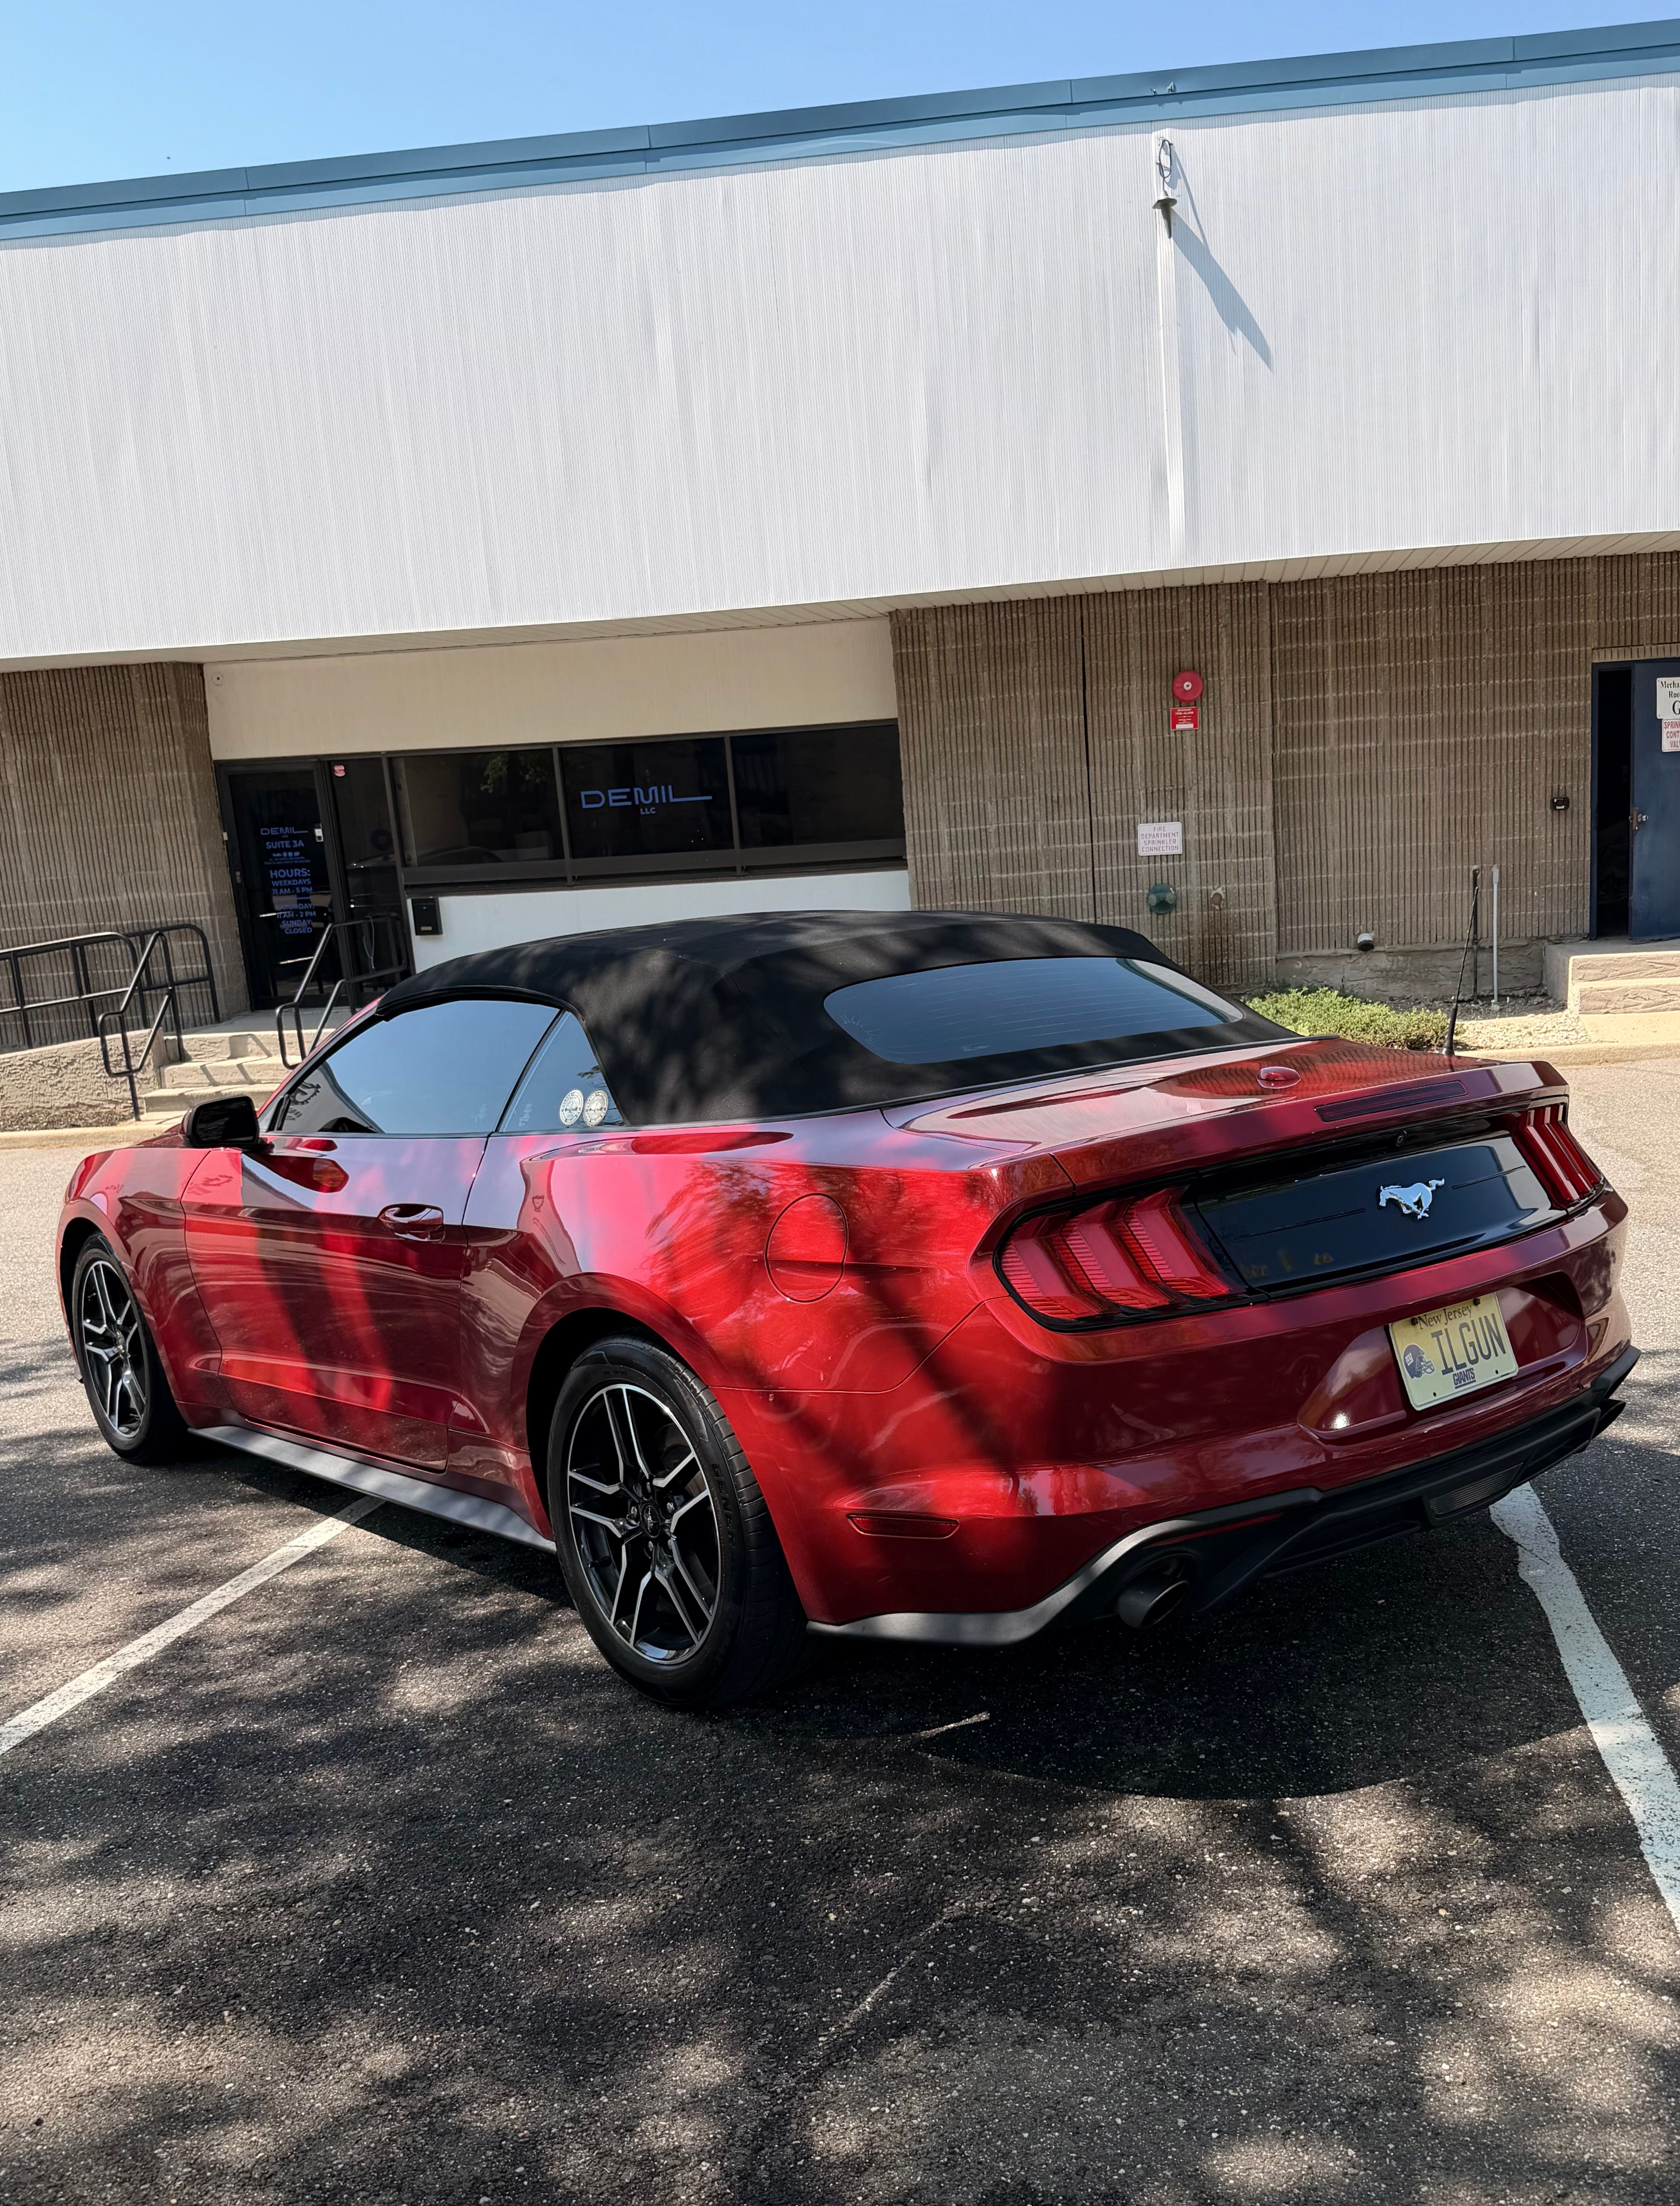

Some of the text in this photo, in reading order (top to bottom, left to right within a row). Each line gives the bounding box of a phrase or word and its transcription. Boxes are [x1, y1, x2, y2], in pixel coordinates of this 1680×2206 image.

[1660, 680, 1680, 689] Mecha
[1673, 700, 1680, 715] G
[580, 785, 712, 809] DEMIL
[260, 826, 309, 836] DEMIL
[266, 839, 305, 849] SUITE 3A
[270, 867, 310, 878] HOURS:
[1417, 1305, 1472, 1330] New Jersey
[1431, 1313, 1507, 1375] ILGUN
[1452, 1367, 1475, 1386] GIANTS
